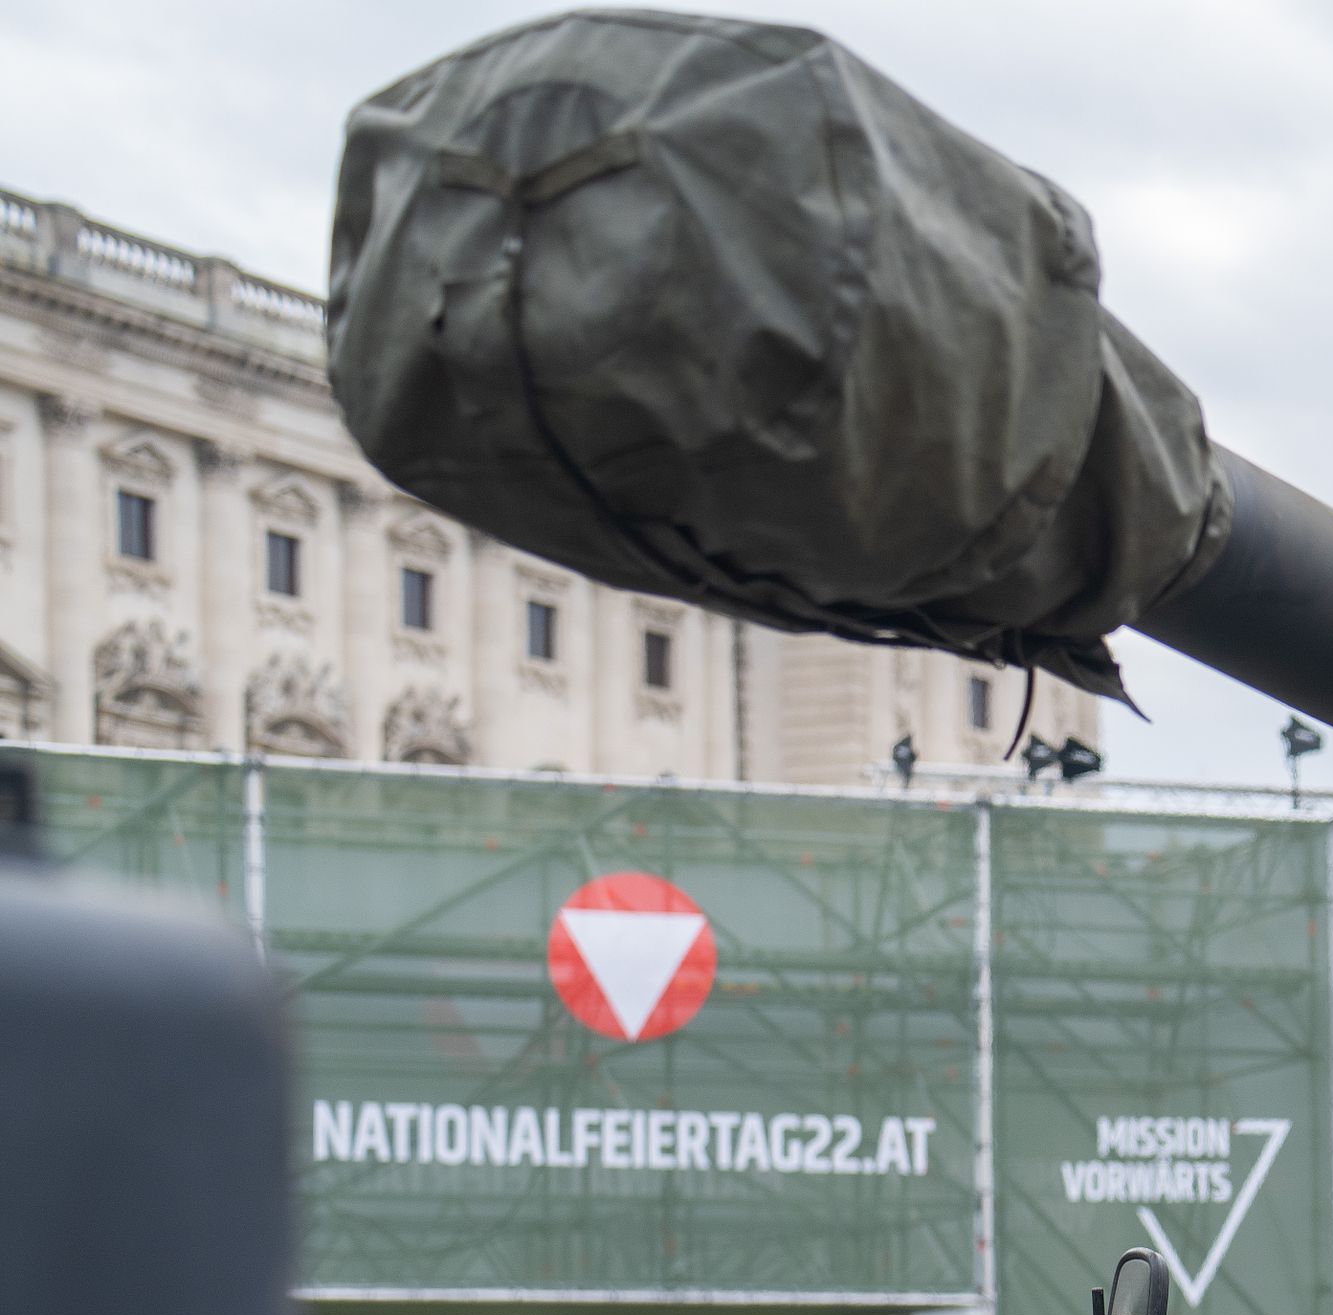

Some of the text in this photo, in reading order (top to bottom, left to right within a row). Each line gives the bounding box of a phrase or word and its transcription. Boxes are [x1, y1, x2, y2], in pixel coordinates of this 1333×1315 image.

[312, 1099, 937, 1176] NATIONALFEIERTAG22.AT
[1096, 1115, 1231, 1159] MISSION
[1061, 1154, 1233, 1204] VORWÄRTS
